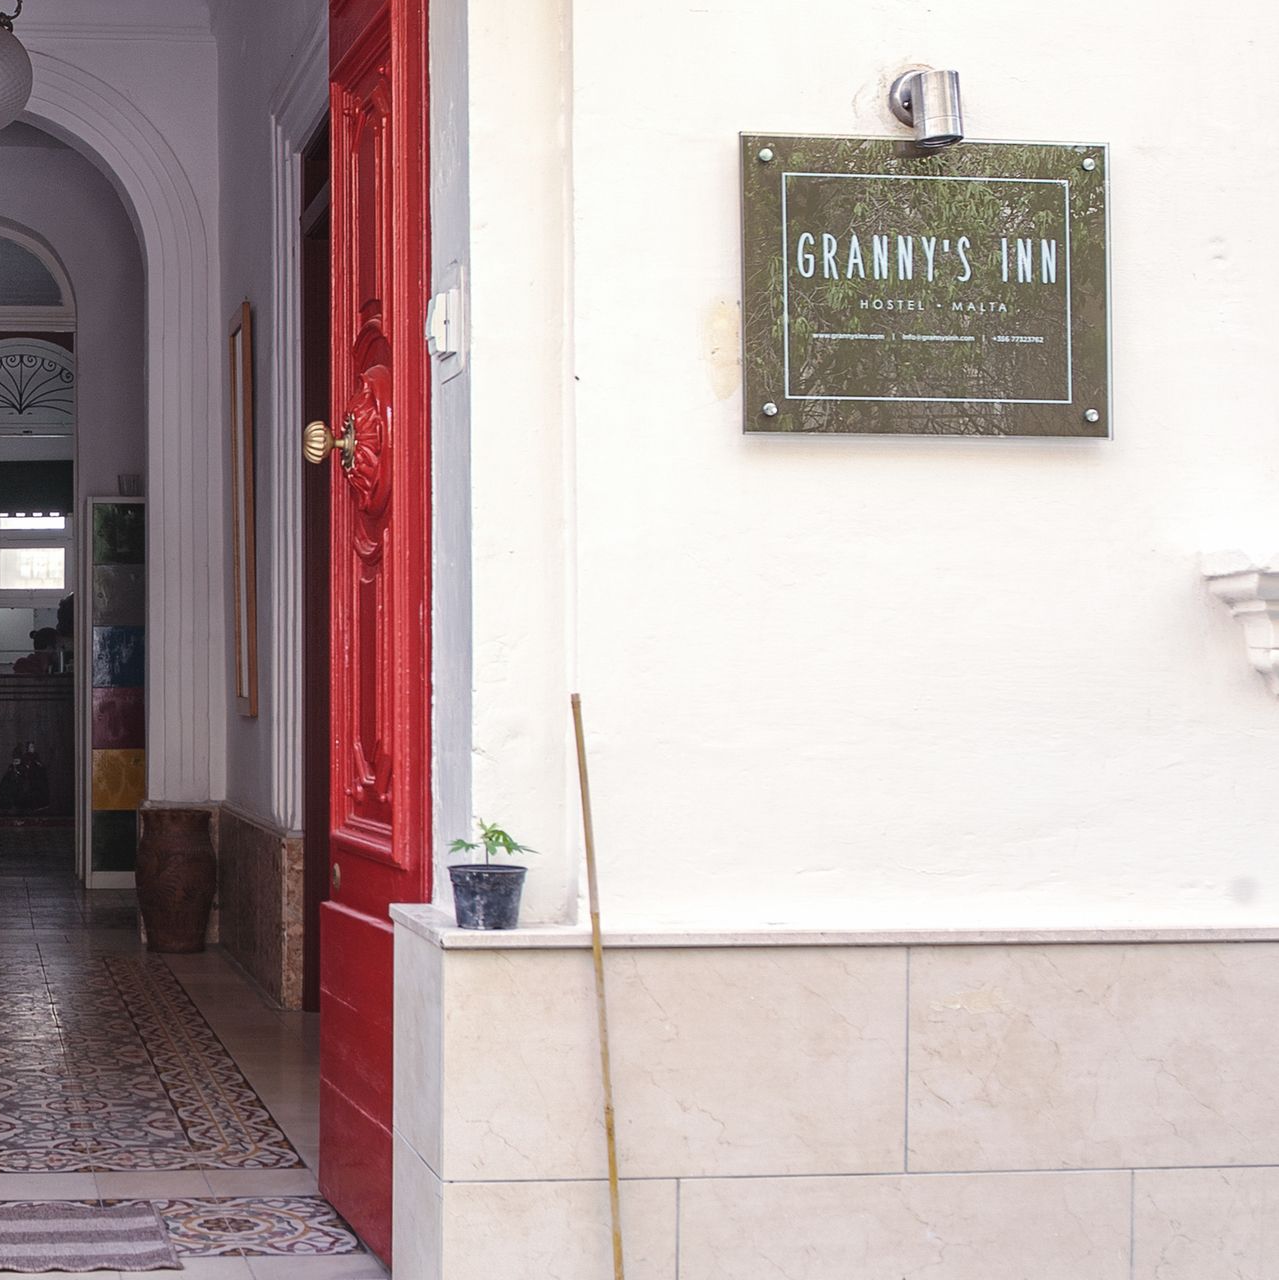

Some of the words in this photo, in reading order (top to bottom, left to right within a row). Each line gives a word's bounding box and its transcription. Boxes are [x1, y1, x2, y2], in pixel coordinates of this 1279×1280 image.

[796, 231, 972, 282] GRANNY'S
[1001, 237, 1057, 284] INN
[860, 299, 925, 311] HOSTEL
[952, 301, 1008, 313] MALTA
